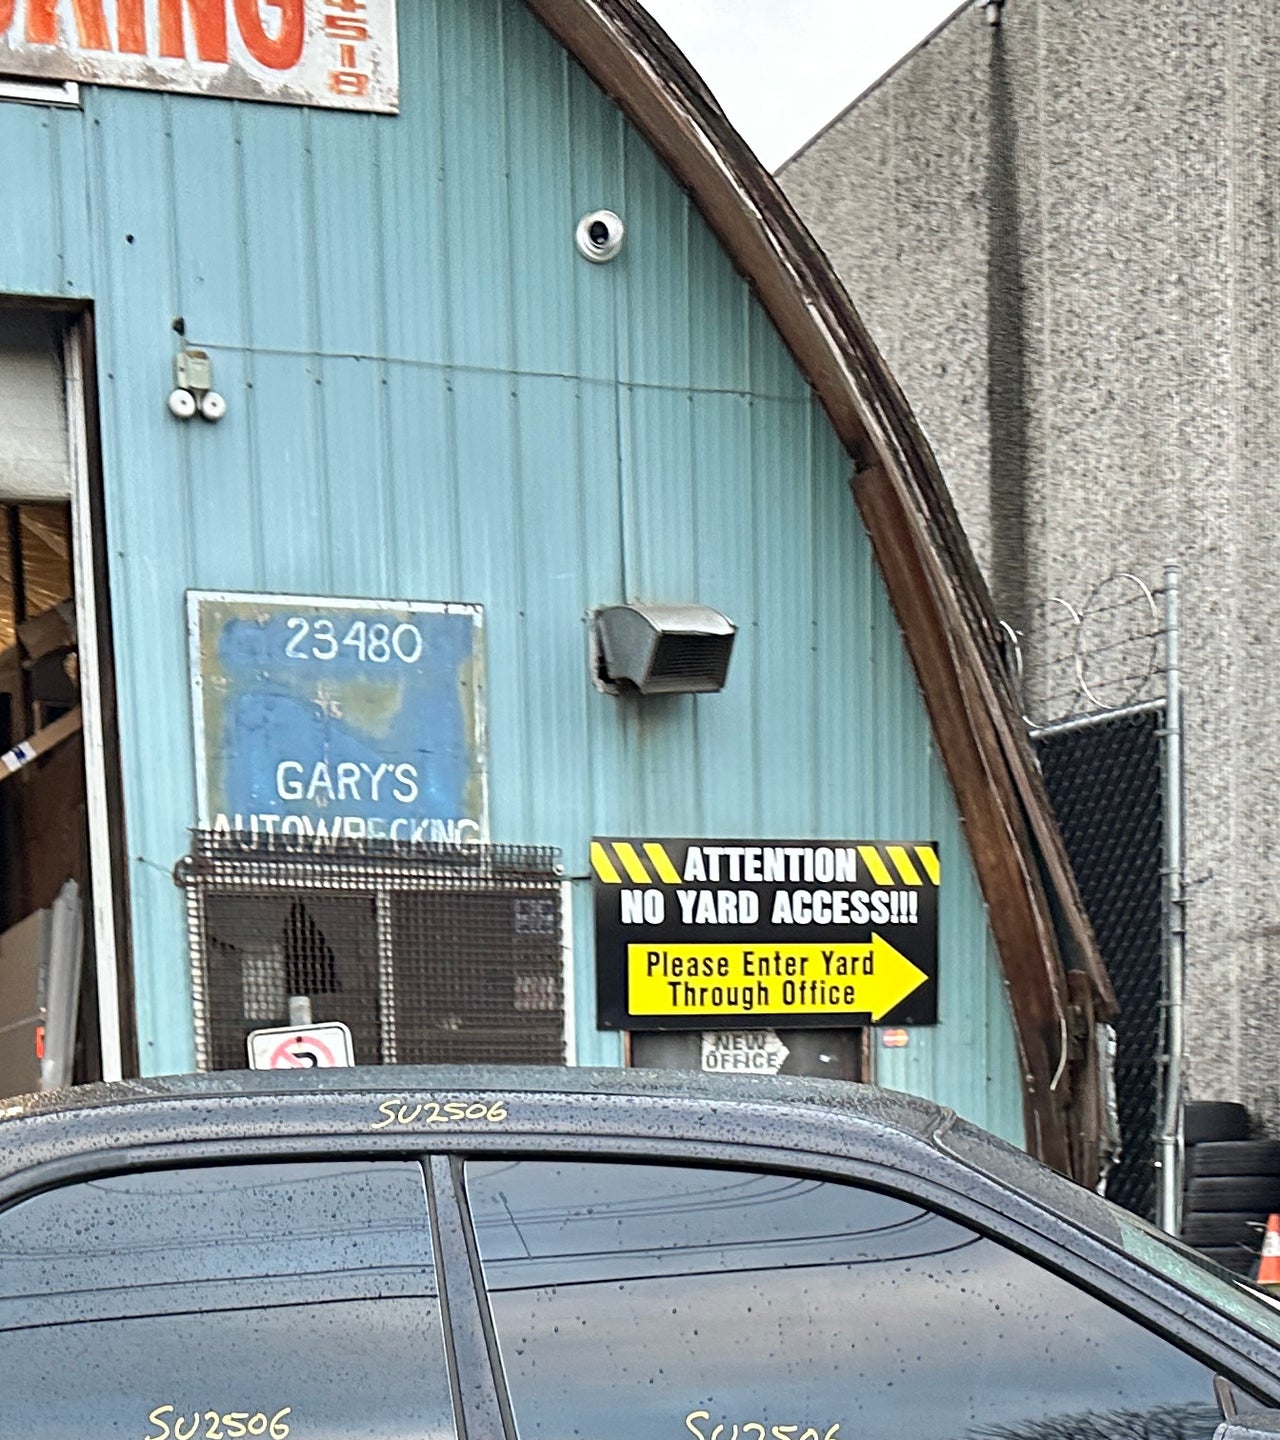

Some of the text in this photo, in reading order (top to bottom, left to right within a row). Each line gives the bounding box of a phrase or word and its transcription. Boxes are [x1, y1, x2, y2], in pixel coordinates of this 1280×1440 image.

[285, 617, 423, 664] 23480
[277, 760, 419, 803] GARY'S
[684, 847, 857, 882] ATTENTION
[621, 889, 918, 925] NO YARD ACCESS!!!
[646, 950, 875, 977] Please Enter Yard
[668, 980, 855, 1011] Through Office
[716, 1033, 765, 1051] NEW
[705, 1051, 778, 1069] OFFICE
[371, 1099, 508, 1129] SU2506
